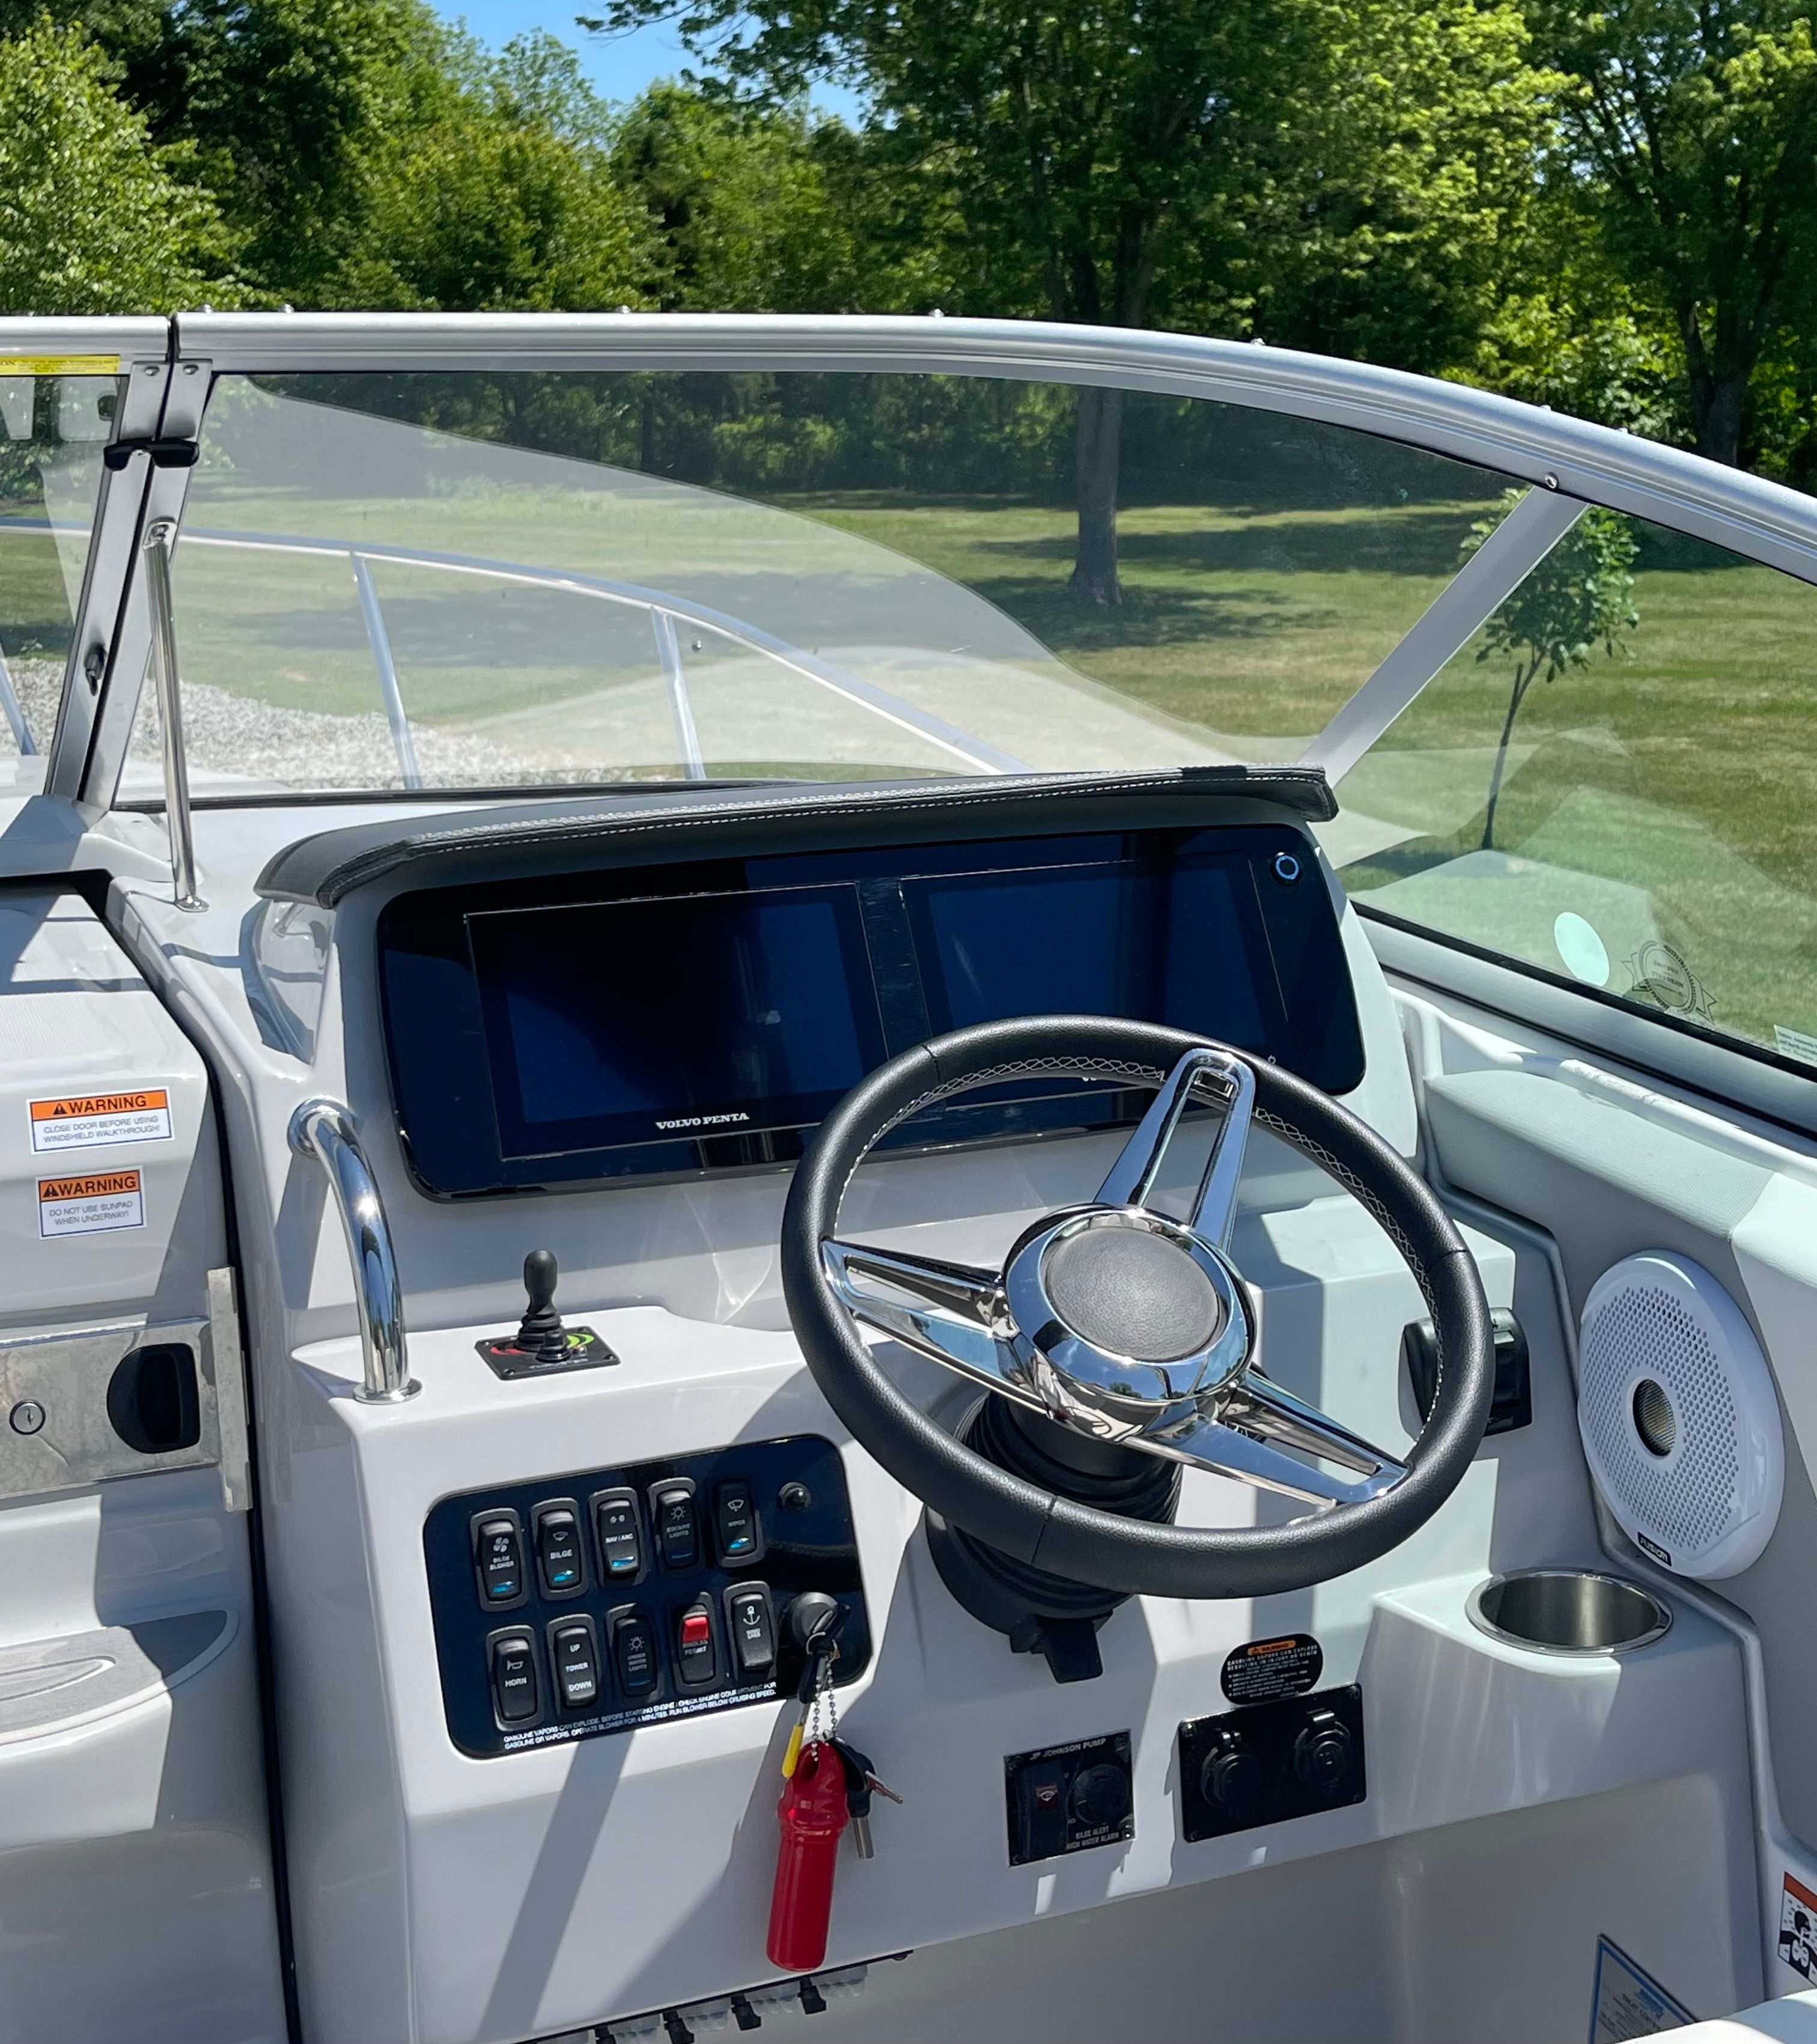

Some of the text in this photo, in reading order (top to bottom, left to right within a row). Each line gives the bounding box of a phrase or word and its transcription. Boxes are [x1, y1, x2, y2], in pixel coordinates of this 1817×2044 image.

[68, 1095, 147, 1114] WARNING
[44, 1115, 159, 1134] CLOSE DOOR BEFORE USING
[656, 1112, 750, 1130] VOLVO PENTA
[44, 1131, 94, 1142] WINDSHIELD
[58, 1176, 136, 1196] WARNING
[64, 1206, 80, 1215] NOT
[82, 1204, 98, 1213] USE
[100, 1200, 133, 1211] SUNPAD
[55, 1211, 129, 1226] WHEN UNDERWAY!
[550, 1549, 573, 1559] BILGE
[489, 1560, 514, 1571] BLOWER
[570, 1643, 580, 1652] UP
[565, 1662, 588, 1672] TOWER
[505, 1677, 527, 1688] HORN
[568, 1681, 592, 1692] DOWN
[504, 1730, 534, 1742] GASOLINE
[534, 1726, 559, 1735] VAPORS
[559, 1723, 573, 1732] CAN
[505, 1738, 535, 1750] GASOLINE
[1042, 1744, 1081, 1757] JOHNSON
[1083, 1738, 1106, 1750] PUMP
